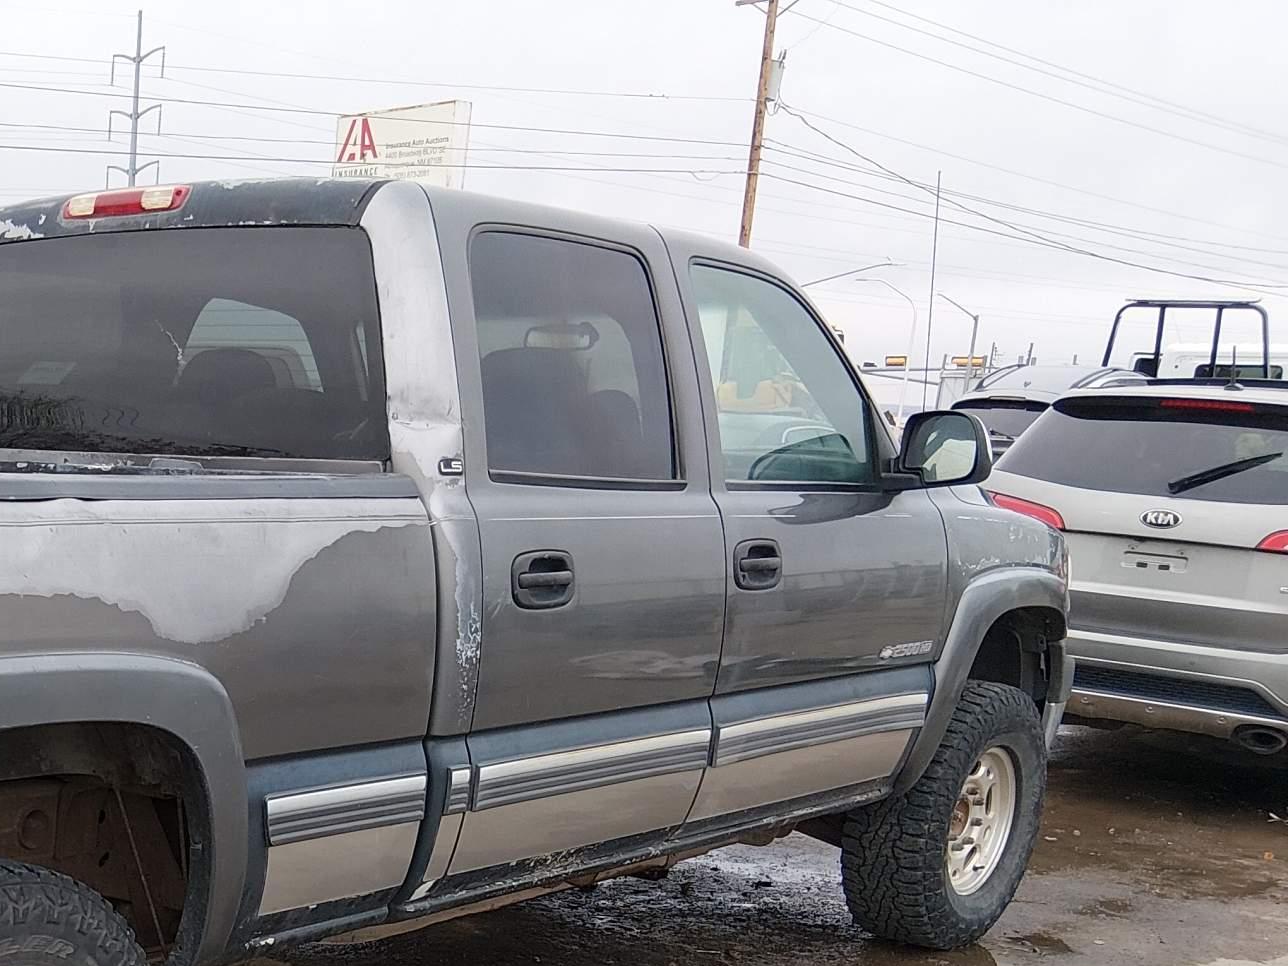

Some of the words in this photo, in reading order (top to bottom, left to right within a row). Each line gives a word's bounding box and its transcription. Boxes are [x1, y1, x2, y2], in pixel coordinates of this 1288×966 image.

[425, 136, 449, 145] Auctions
[440, 461, 462, 472] LS
[1146, 512, 1175, 525] KIA
